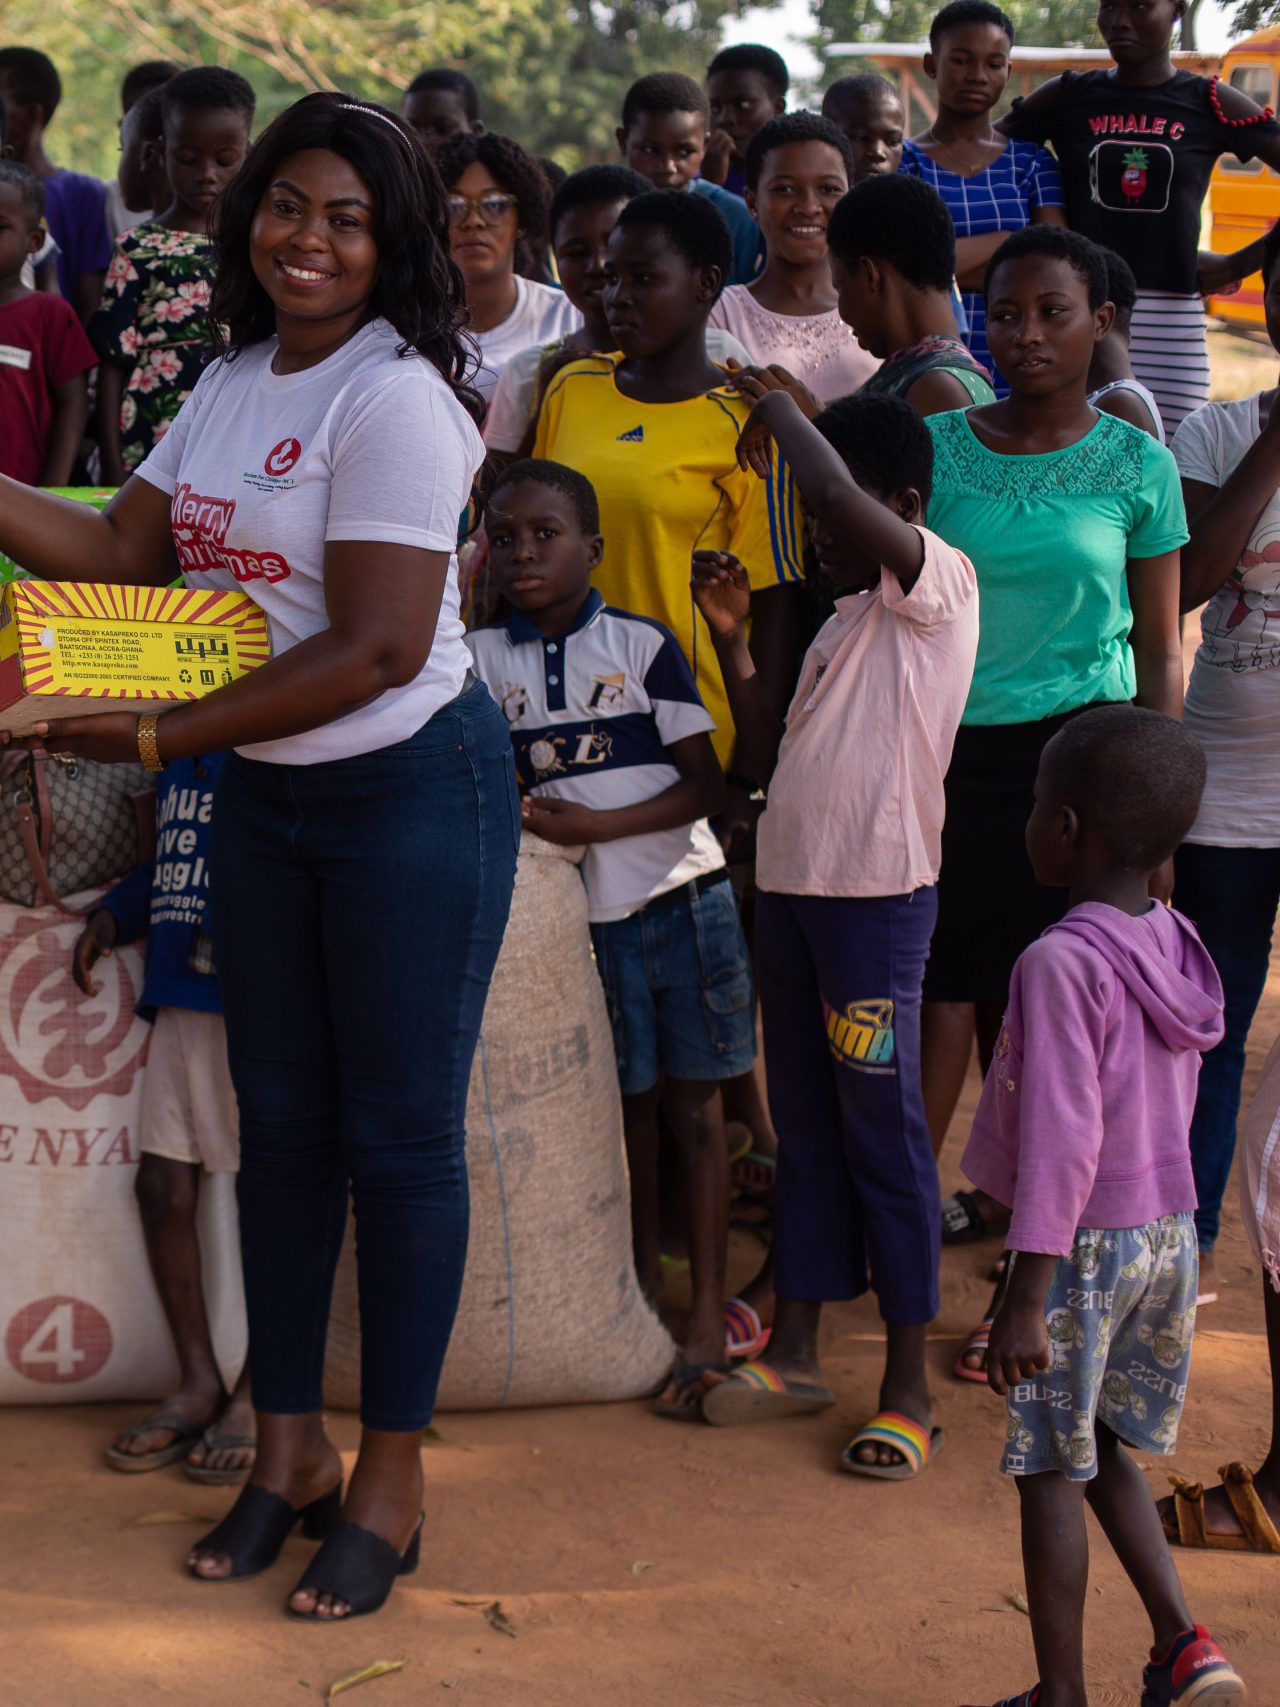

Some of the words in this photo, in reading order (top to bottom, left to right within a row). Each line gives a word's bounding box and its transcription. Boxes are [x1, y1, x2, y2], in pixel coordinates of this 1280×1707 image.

[1088, 113, 1167, 136] WHALE
[1169, 121, 1185, 140] C
[57, 628, 91, 636] PRODUCED
[102, 630, 138, 638] KASAPREKO
[94, 637, 120, 645] SPINTEX
[25, 1125, 141, 1167] NYA
[21, 1303, 85, 1376] 4
